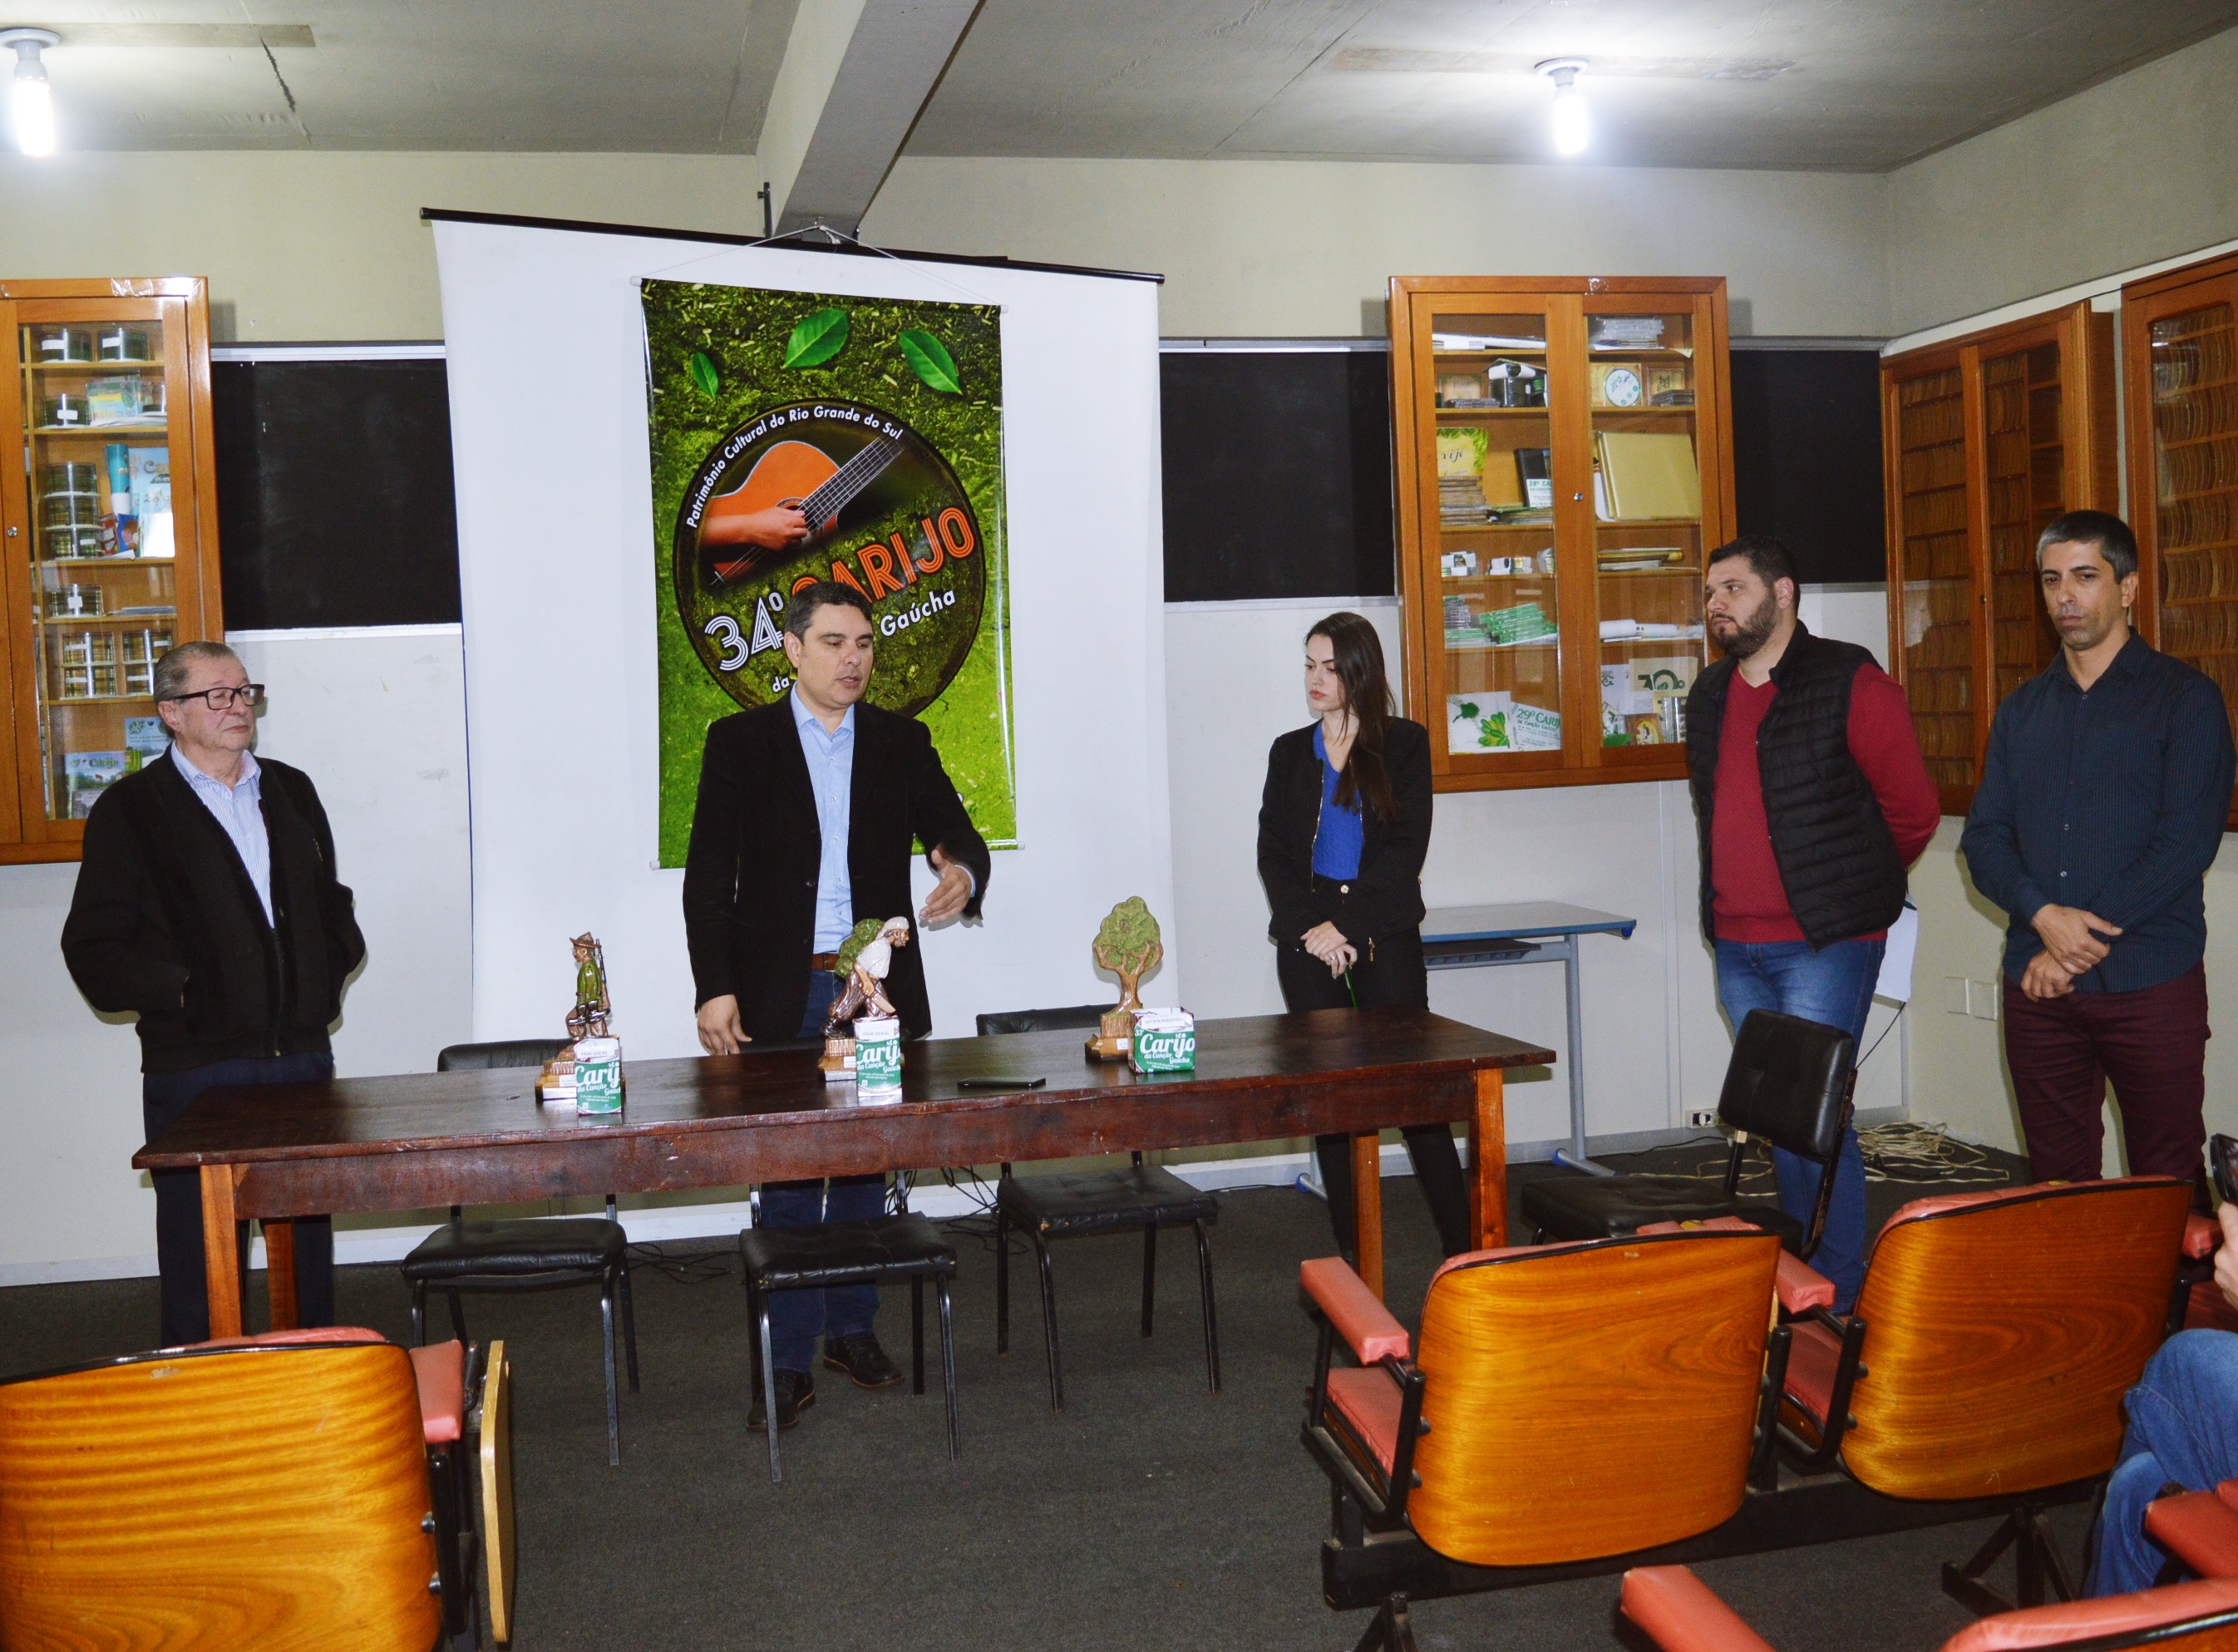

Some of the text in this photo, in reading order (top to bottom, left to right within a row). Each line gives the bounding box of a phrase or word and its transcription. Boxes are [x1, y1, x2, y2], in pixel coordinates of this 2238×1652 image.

[686, 405, 904, 529] Patrimônio Cultural do Rio Grande do Sul
[704, 507, 975, 671] 34º ARIJO
[772, 589, 956, 693] da Gaúcha
[1516, 708, 1536, 720] 29º
[1140, 1033, 1195, 1058] Carijo
[1152, 1052, 1172, 1060] Canção
[1169, 1057, 1190, 1065] Gaúcha
[865, 1061, 886, 1070] Canção
[585, 1082, 608, 1092] Canção
